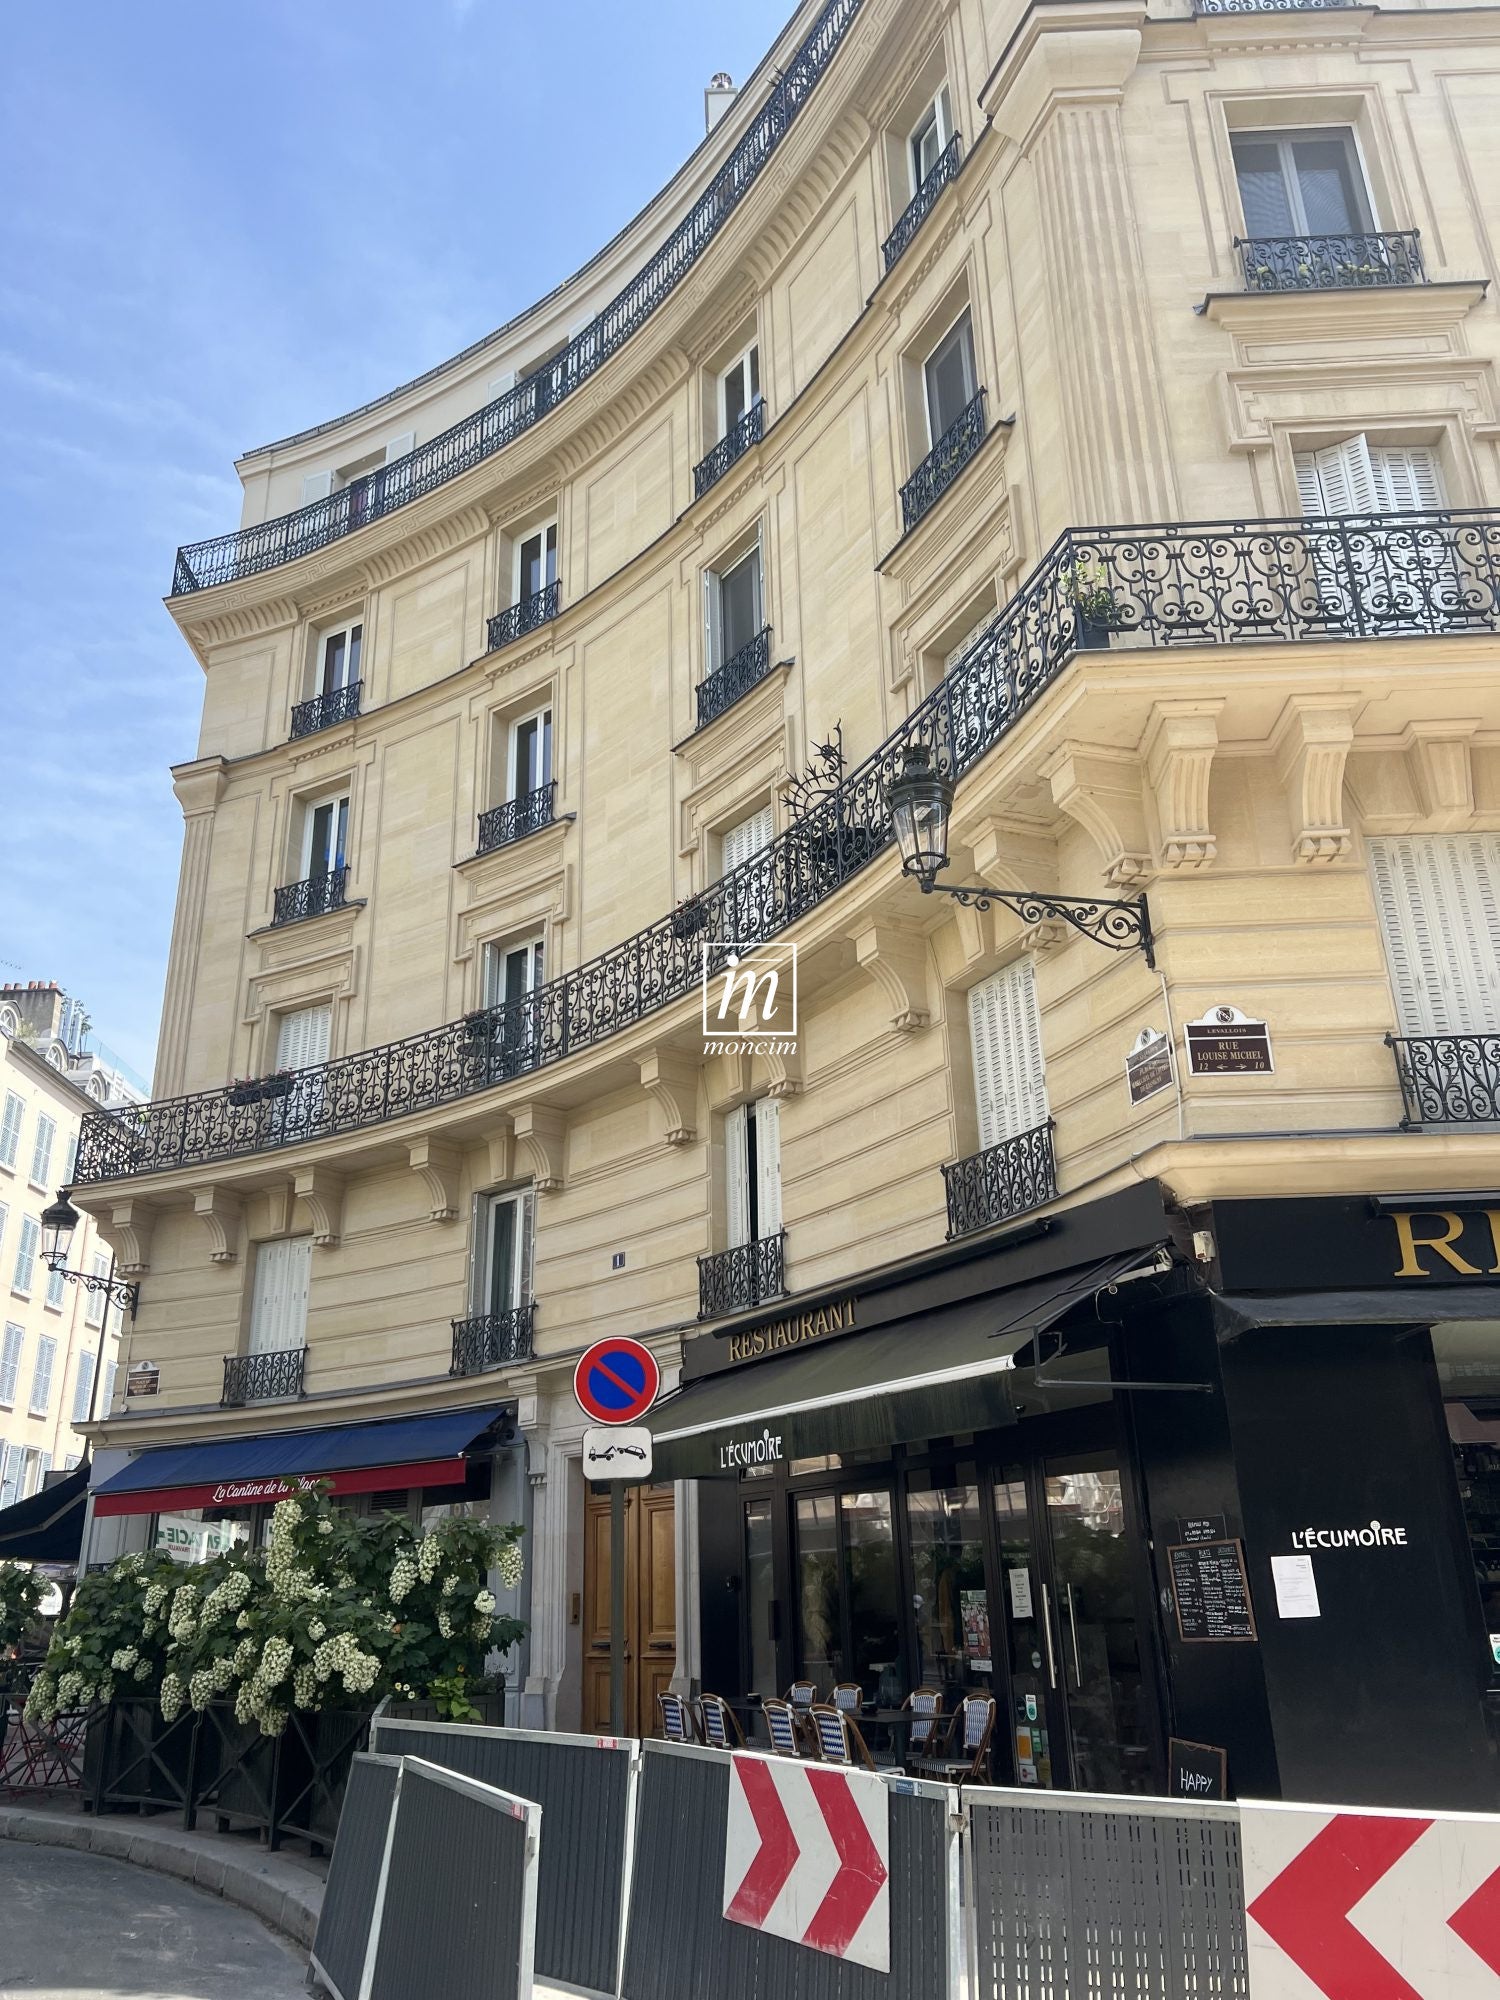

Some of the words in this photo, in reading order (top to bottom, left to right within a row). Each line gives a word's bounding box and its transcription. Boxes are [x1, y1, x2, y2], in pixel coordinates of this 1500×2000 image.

[1197, 1052, 1228, 1061] LOUISE
[1230, 1051, 1263, 1060] MICHEL
[1218, 1041, 1239, 1050] RUE
[1199, 1062, 1209, 1071] 12
[1255, 1061, 1265, 1070] 10
[1391, 1210, 1500, 1277] R
[729, 1299, 859, 1362] RESTAURANT
[720, 1428, 783, 1469] L'ÉCUMOIRE
[212, 1485, 226, 1502] La
[226, 1482, 262, 1498] Cantine
[263, 1480, 277, 1494] de
[1291, 1520, 1408, 1549] L'ÉCUMOIRE
[1180, 1767, 1213, 1793] HAPPY
